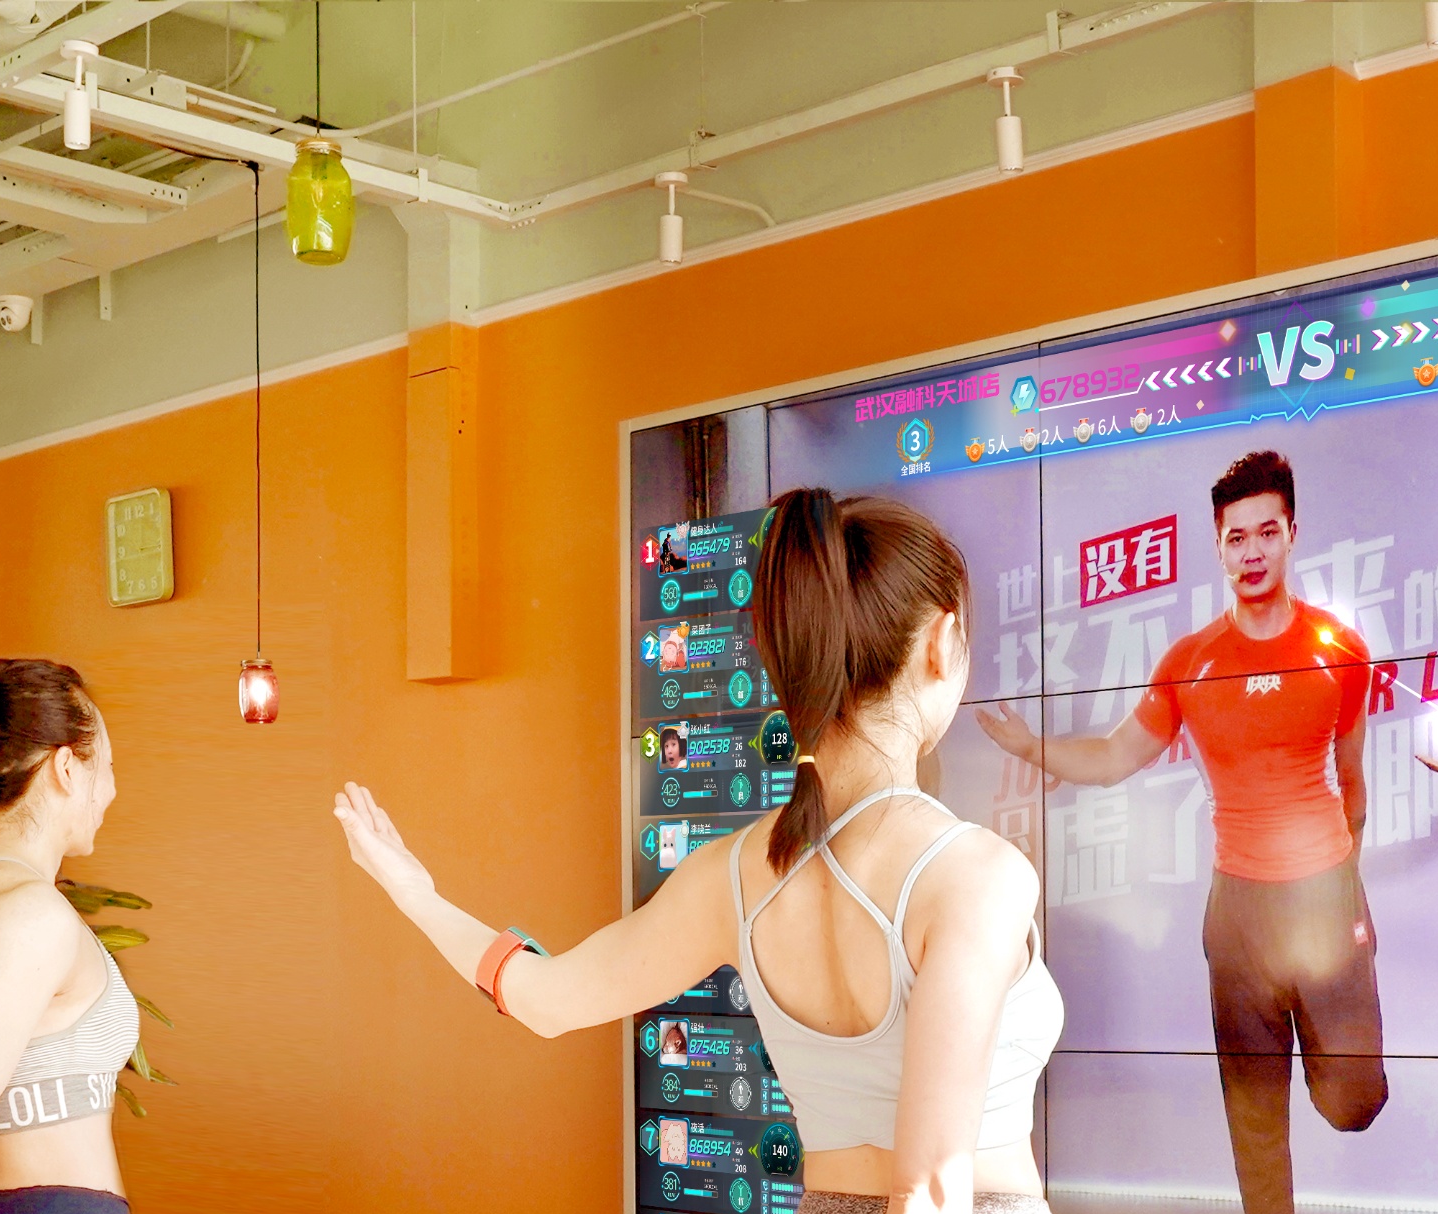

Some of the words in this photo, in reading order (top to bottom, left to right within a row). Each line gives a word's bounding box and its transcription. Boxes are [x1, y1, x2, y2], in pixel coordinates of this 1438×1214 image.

[1257, 320, 1335, 387] VS
[1040, 364, 1140, 403] 678932
[855, 372, 1000, 422] 武汉融科天城店
[1158, 405, 1181, 426] 2人
[1098, 416, 1121, 436] 6人
[911, 431, 921, 452] 3
[1042, 425, 1064, 445] 2人
[987, 435, 1010, 455] 5人
[900, 461, 931, 476] 全国排名
[645, 540, 654, 563] 1
[689, 538, 730, 557] 965479
[735, 540, 743, 549] 12
[735, 557, 747, 566] 164
[997, 556, 1080, 626] 世上
[1085, 523, 1173, 602] 没有
[645, 637, 655, 660] 2
[689, 638, 726, 656] 923821
[735, 641, 743, 649] 23
[735, 657, 747, 667] 176
[663, 685, 678, 698] 462
[645, 733, 655, 757] 3
[689, 738, 730, 755] 902538
[735, 742, 743, 751] 26
[771, 732, 788, 745] 128
[734, 759, 747, 768] 182
[663, 784, 678, 796] 423
[645, 830, 655, 853] 4
[645, 1027, 655, 1051] 6
[689, 1039, 730, 1055] 875426
[735, 1046, 744, 1054] 36
[735, 1063, 747, 1072] 203
[663, 1079, 678, 1092] 384
[645, 1127, 655, 1150] 7
[689, 1139, 732, 1156] 868954
[735, 1147, 744, 1156] 40
[772, 1144, 788, 1157] 140
[735, 1164, 747, 1173] 208
[663, 1177, 678, 1191] 381
